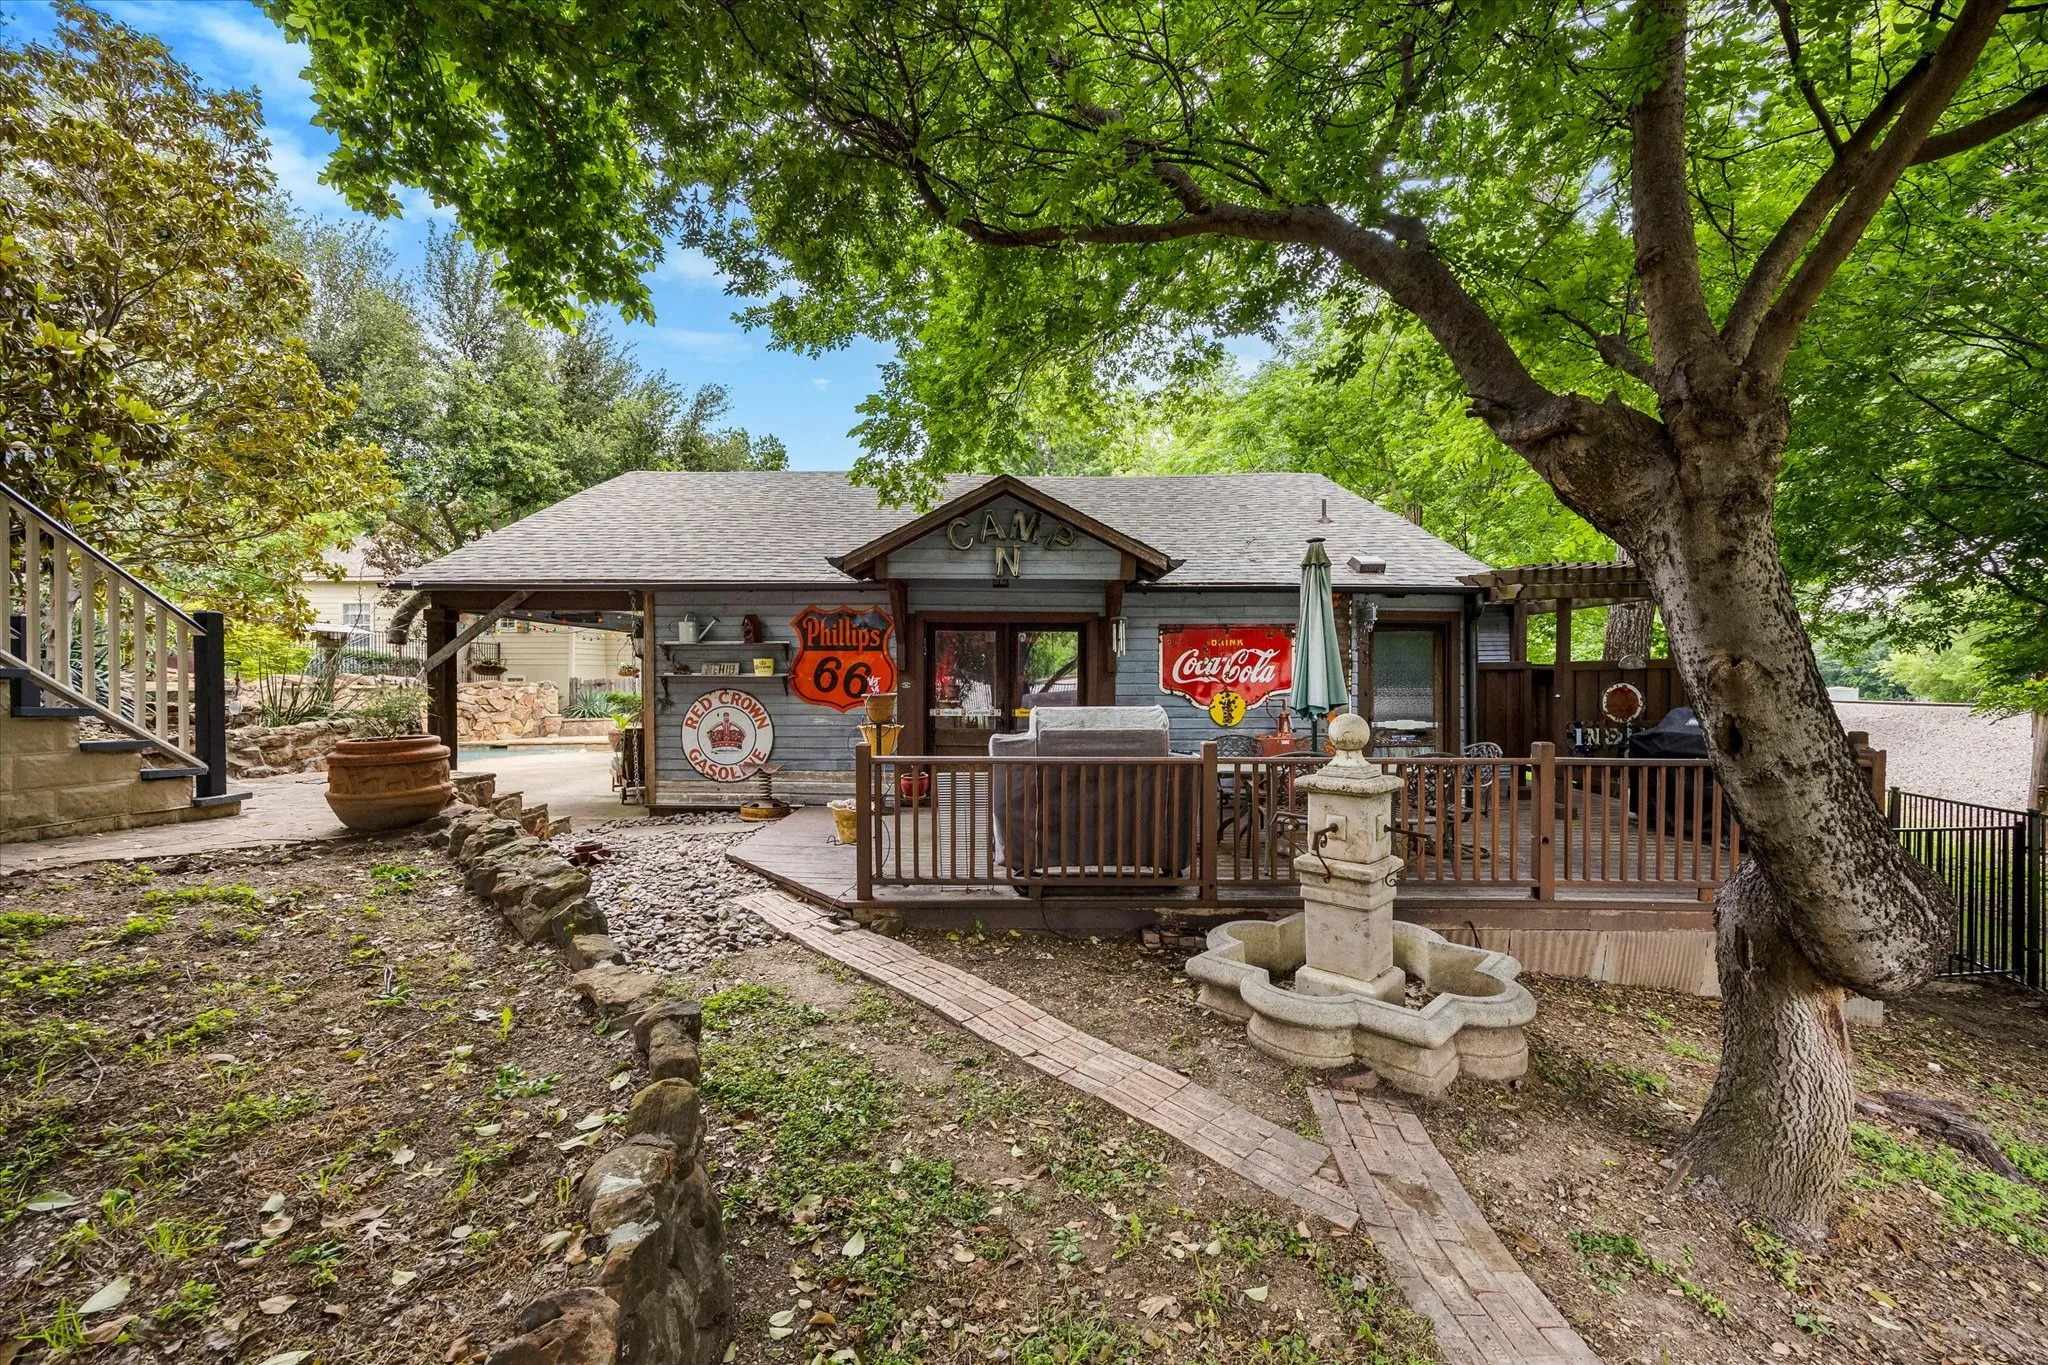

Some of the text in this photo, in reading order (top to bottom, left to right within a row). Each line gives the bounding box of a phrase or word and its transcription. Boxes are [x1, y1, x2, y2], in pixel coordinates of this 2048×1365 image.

[947, 509, 1076, 551] CAMP
[995, 544, 1020, 578] N
[802, 616, 880, 655] Phillips
[1211, 639, 1244, 647] DRINK
[813, 656, 872, 698] 66
[1172, 648, 1280, 684] Coca-Cola
[684, 692, 770, 730] RED CROWN
